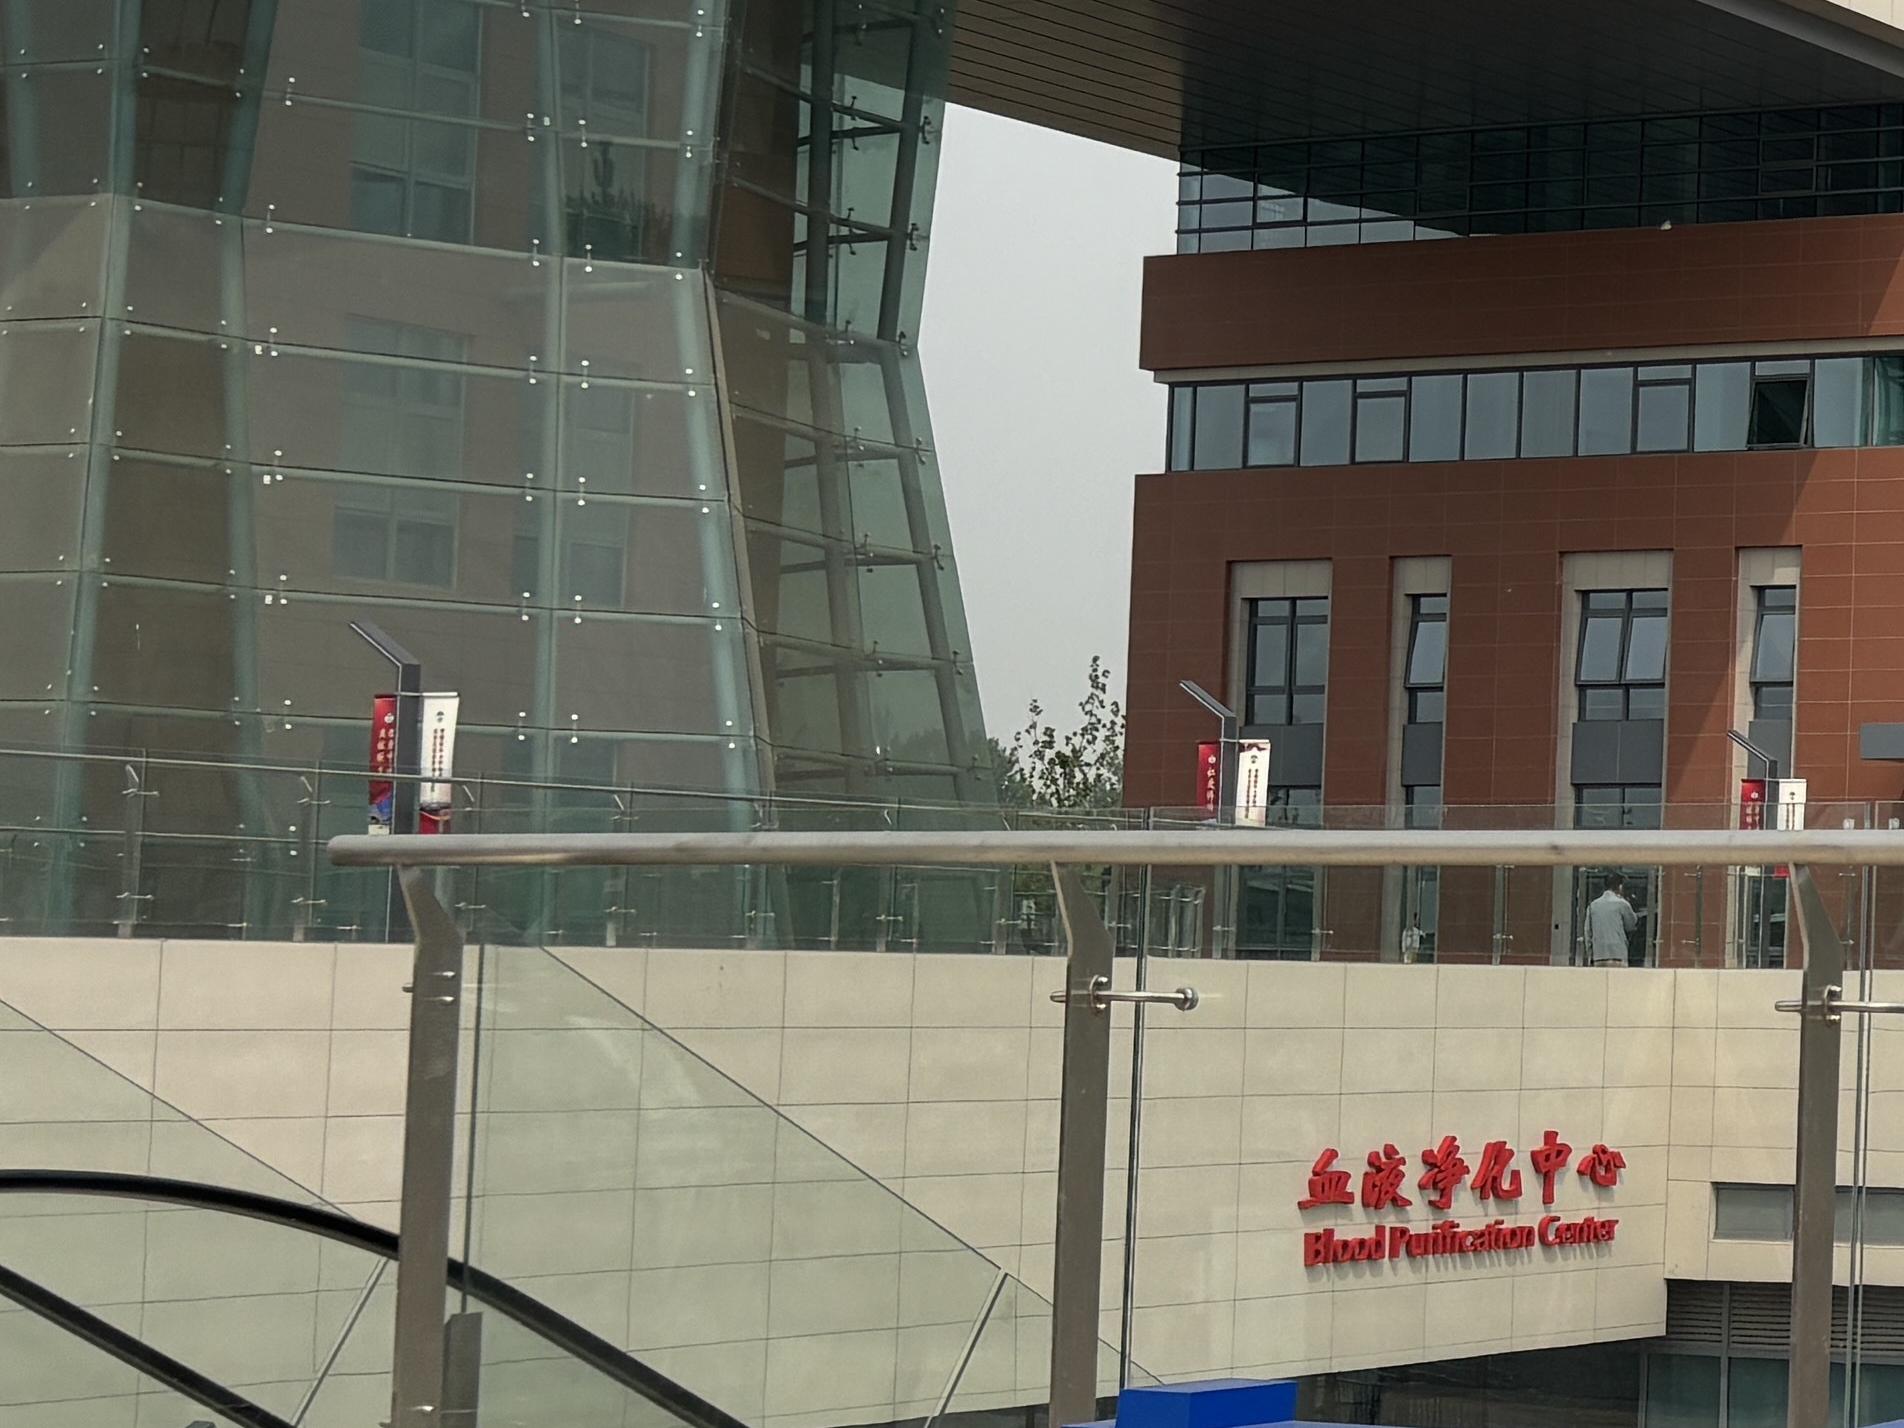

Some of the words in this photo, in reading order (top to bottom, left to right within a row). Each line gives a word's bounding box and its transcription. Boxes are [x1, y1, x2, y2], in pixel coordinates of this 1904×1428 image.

[1297, 1129, 1627, 1211] 血液净化中心
[1303, 1223, 1386, 1267] Blood
[1388, 1217, 1536, 1259] Purification
[1537, 1213, 1620, 1246] Center
